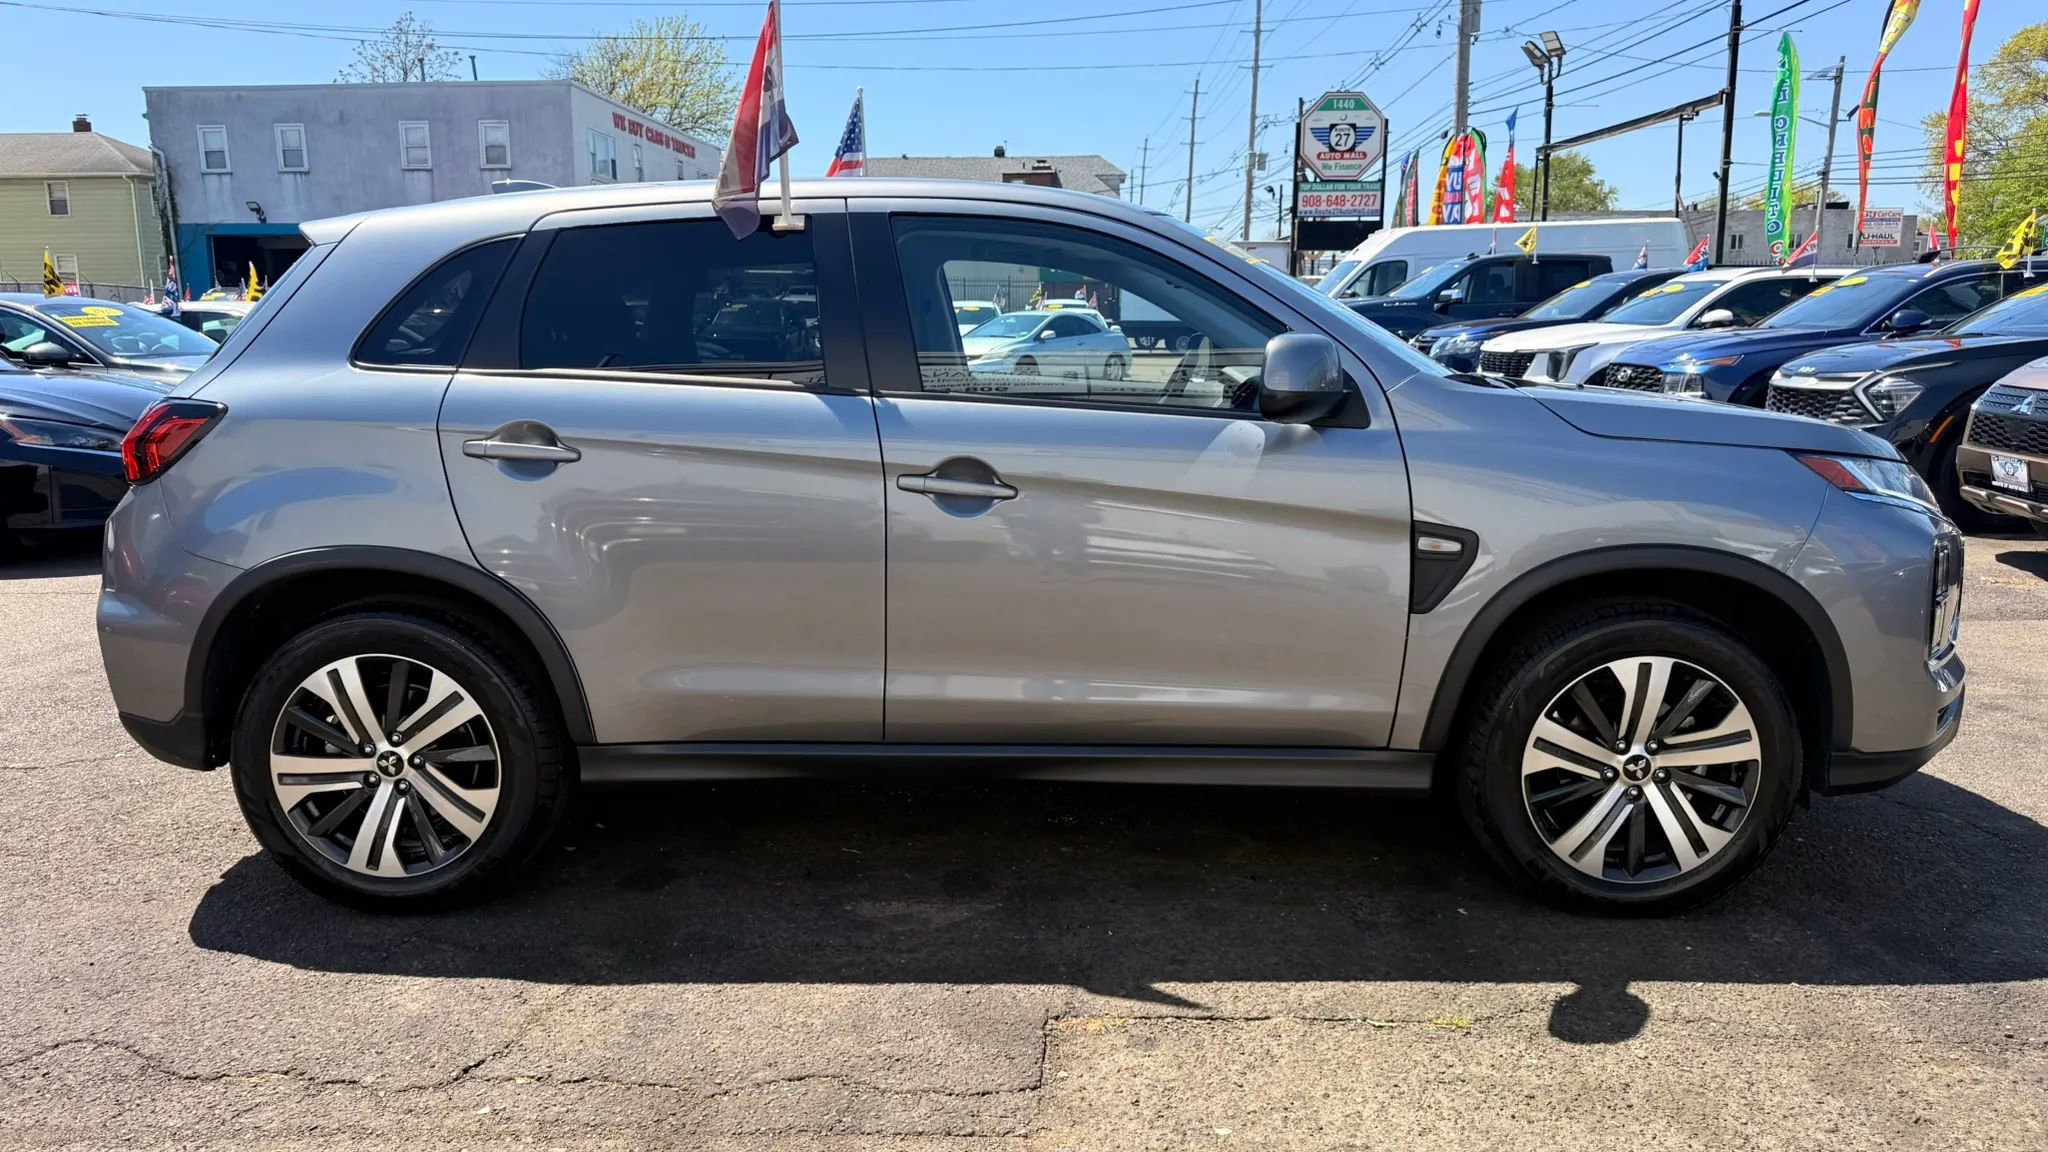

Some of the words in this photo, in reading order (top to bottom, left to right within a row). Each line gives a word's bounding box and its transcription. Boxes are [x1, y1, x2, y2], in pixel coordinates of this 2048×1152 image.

[1333, 99, 1355, 109] 1440
[612, 112, 626, 131] WE
[628, 119, 644, 138] BUY
[646, 126, 664, 146] CARS
[1335, 133, 1351, 147] 27
[1335, 162, 1361, 170] Finance
[1302, 194, 1377, 207] 908-648-2727
